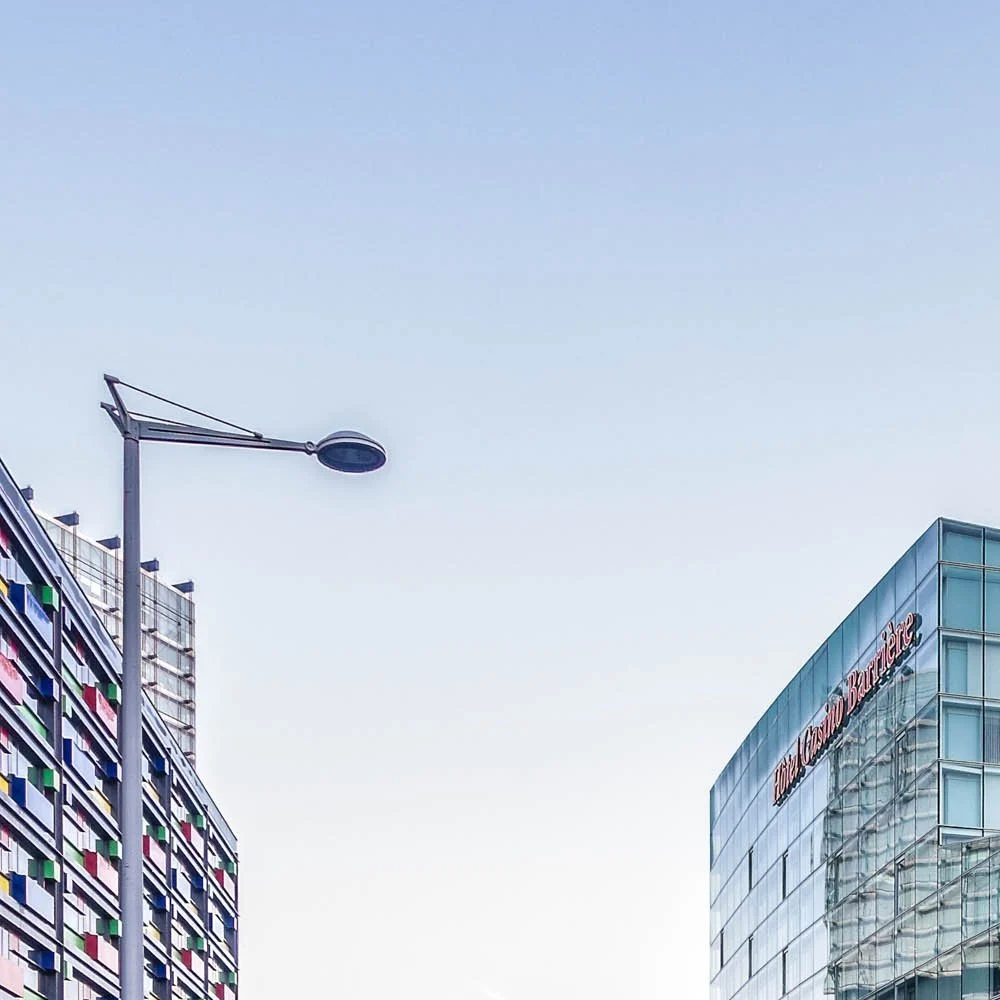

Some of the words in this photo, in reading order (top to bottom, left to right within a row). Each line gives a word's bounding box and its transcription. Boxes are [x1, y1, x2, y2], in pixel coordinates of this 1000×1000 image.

[773, 736, 802, 803] Hôtel
[801, 697, 845, 767] Casino
[847, 612, 915, 715] Barrière
